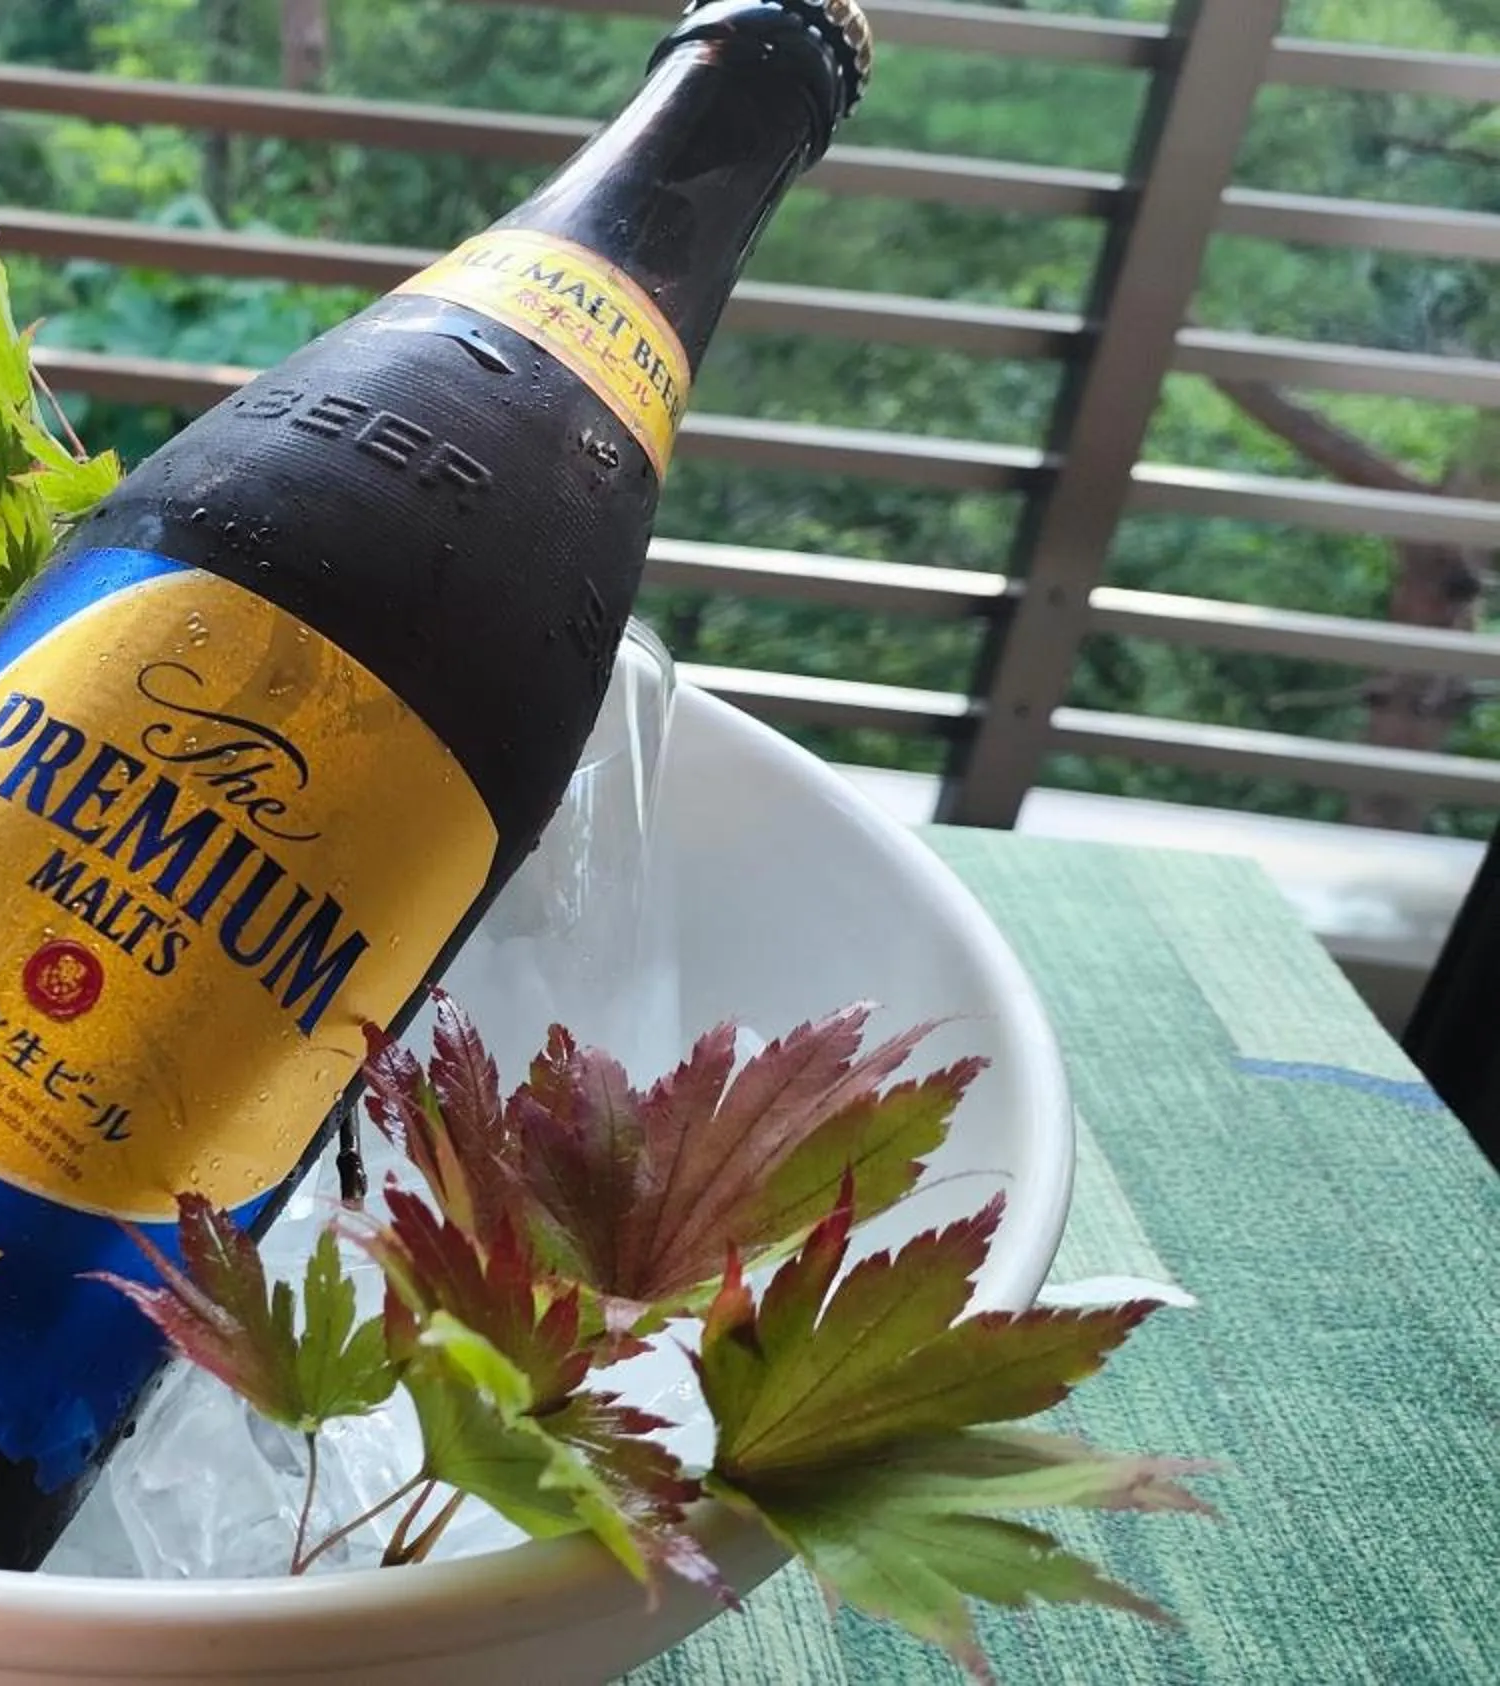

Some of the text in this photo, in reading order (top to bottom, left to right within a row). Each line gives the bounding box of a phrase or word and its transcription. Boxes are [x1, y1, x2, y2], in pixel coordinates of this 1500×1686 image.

[518, 261, 633, 338] MALT
[234, 390, 493, 485] BEER
[136, 660, 323, 842] The
[25, 846, 193, 978] MALT'S
